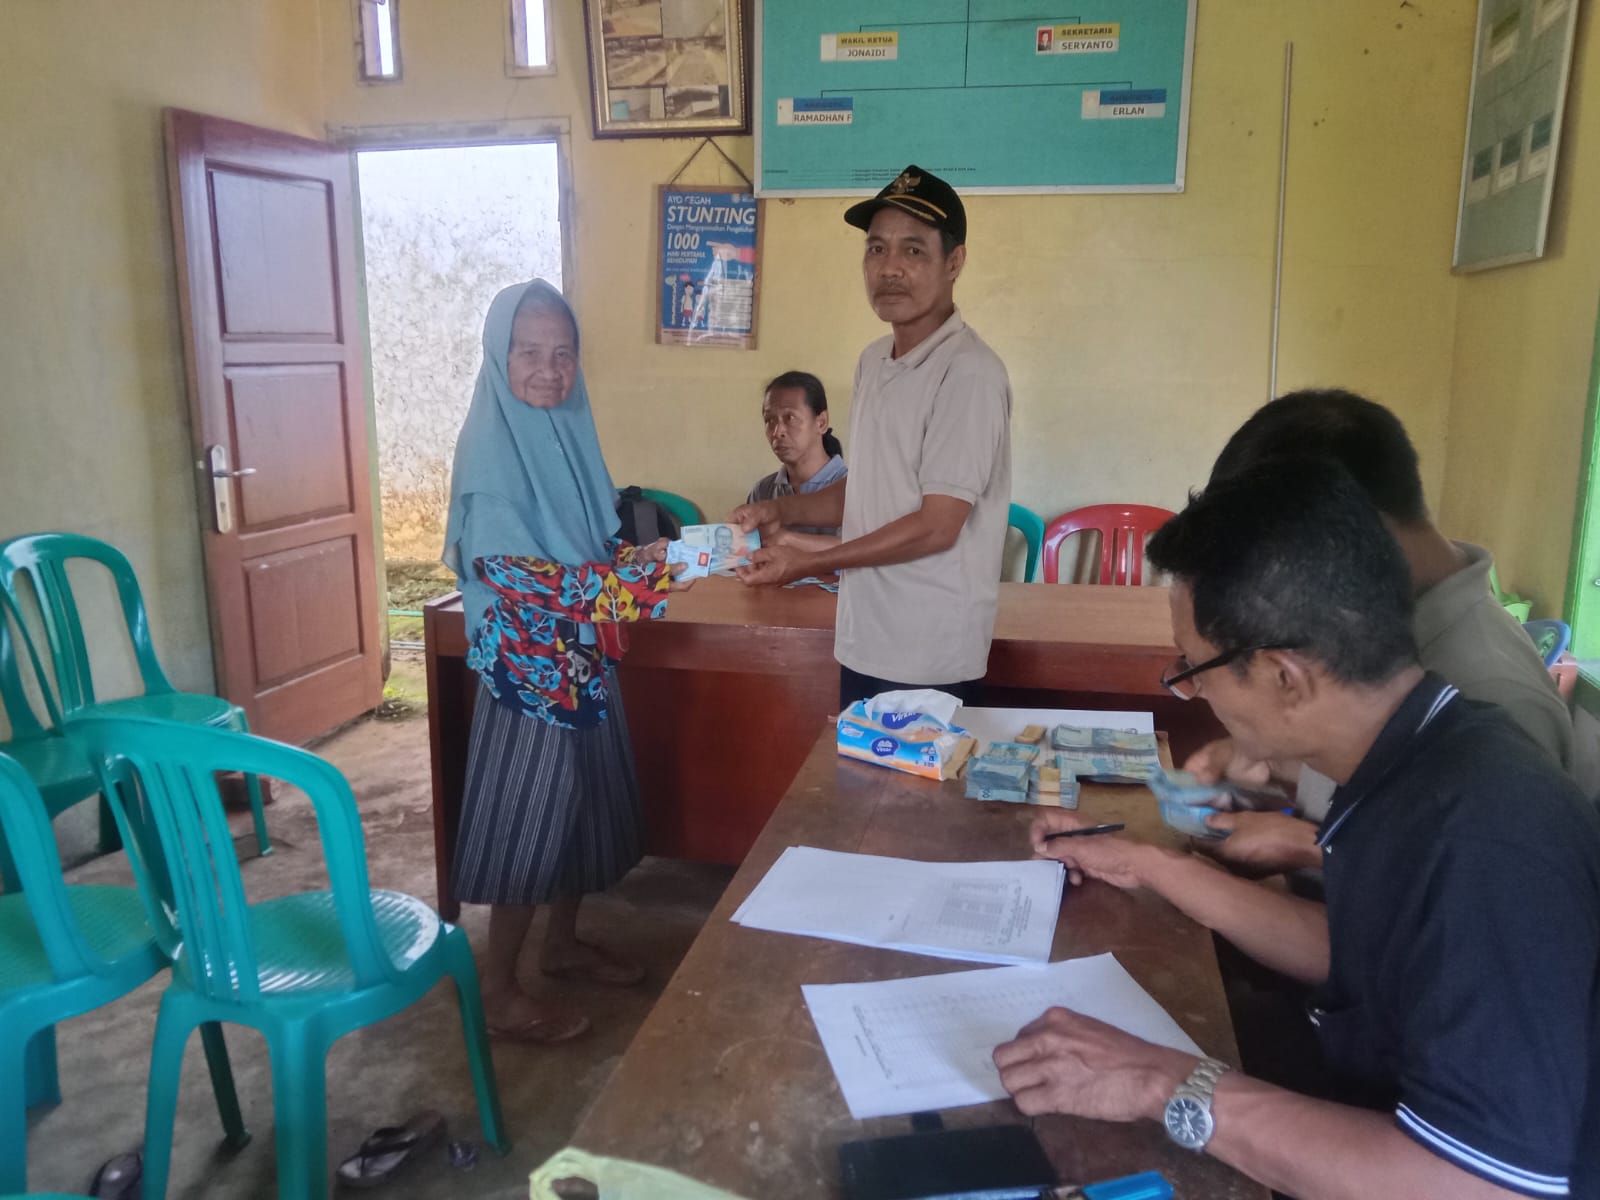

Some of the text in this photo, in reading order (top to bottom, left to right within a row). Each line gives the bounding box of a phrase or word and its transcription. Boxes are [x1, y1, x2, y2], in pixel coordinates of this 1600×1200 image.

[1062, 40, 1113, 50] SERYANTO
[848, 48, 886, 57] JONAIDI
[1112, 106, 1145, 116] ERLAN
[794, 113, 844, 122] RAMADHAN
[667, 205, 756, 225] STUNTING
[667, 232, 700, 250] 1000
